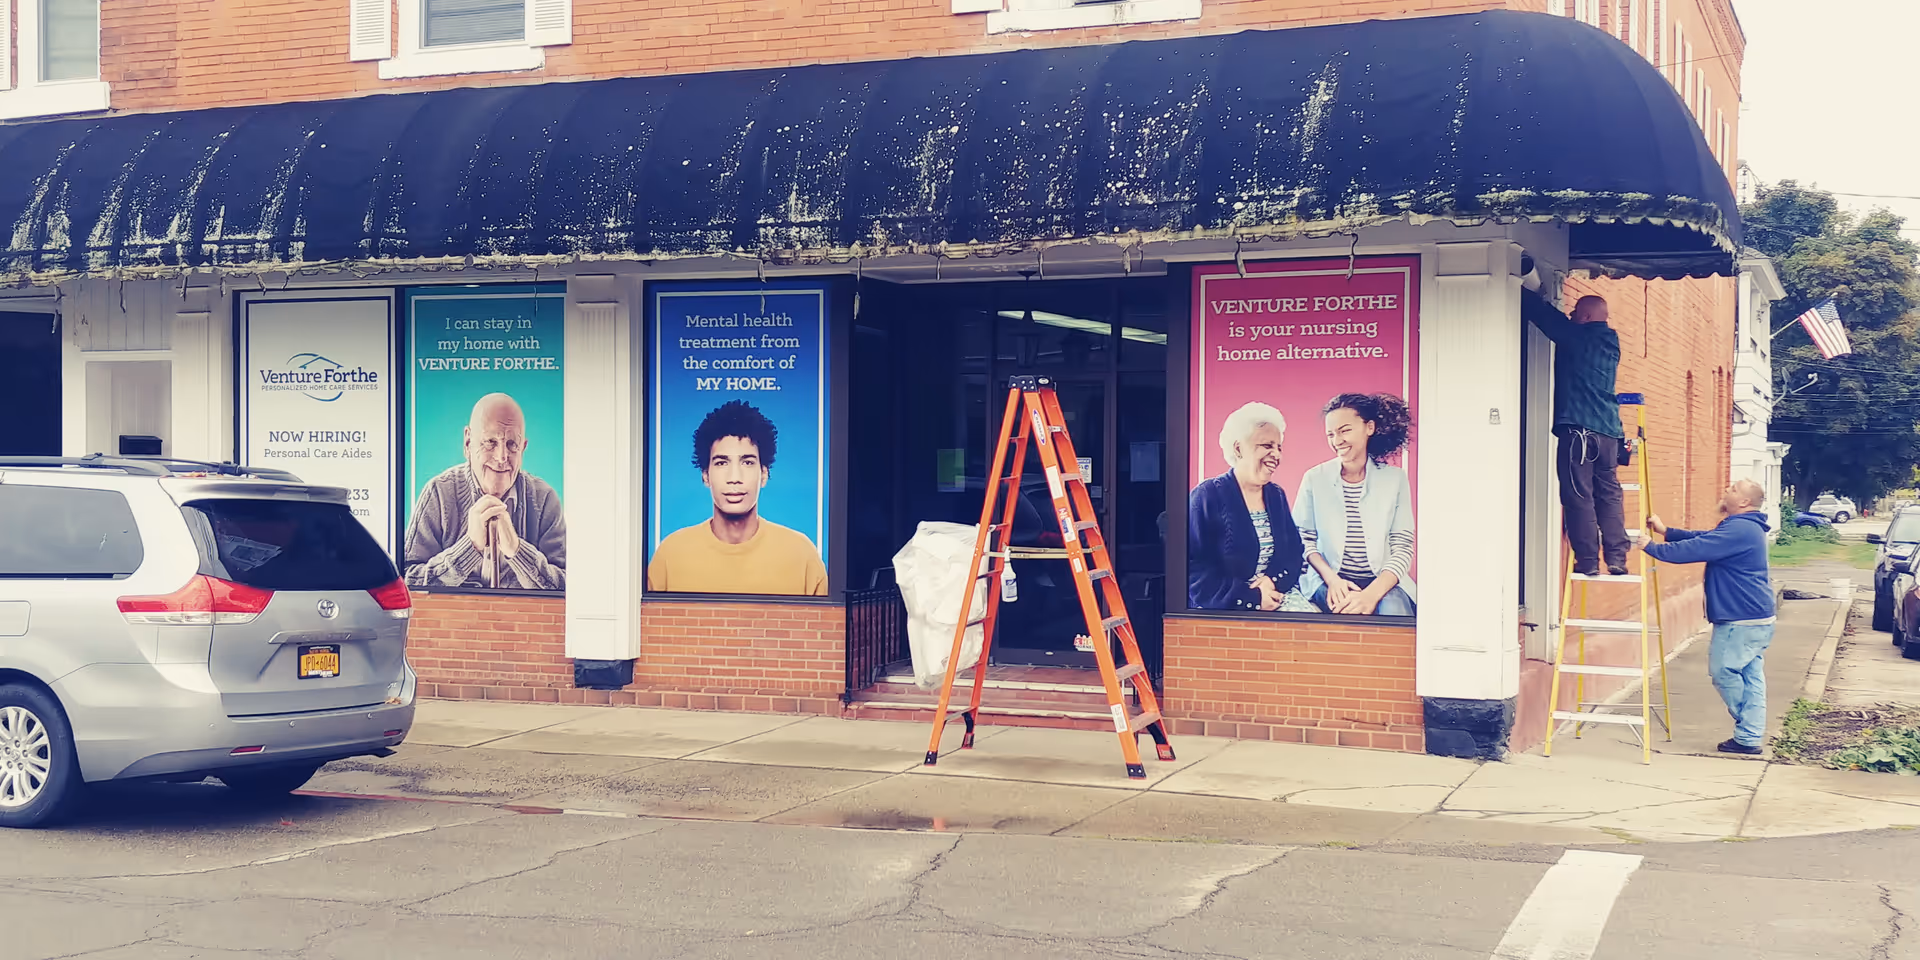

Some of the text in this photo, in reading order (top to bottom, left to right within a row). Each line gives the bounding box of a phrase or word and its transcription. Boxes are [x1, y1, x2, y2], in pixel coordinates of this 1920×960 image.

[1211, 294, 1397, 315] VENTURE FORTHE
[445, 315, 532, 333] I can stay in
[686, 312, 793, 328] Mental health
[1229, 318, 1378, 341] is your nursing
[438, 335, 541, 354] my home with
[679, 334, 800, 349] treatment from
[1217, 342, 1388, 361] home alternative.
[418, 357, 560, 370] VENTURE FORTHE.
[683, 355, 797, 369] the comfort of
[260, 366, 378, 384] Venture Forthe
[696, 377, 781, 391] MY HOME.
[269, 431, 366, 443] NOW HIRING!
[264, 448, 372, 458] Personal Care Aides
